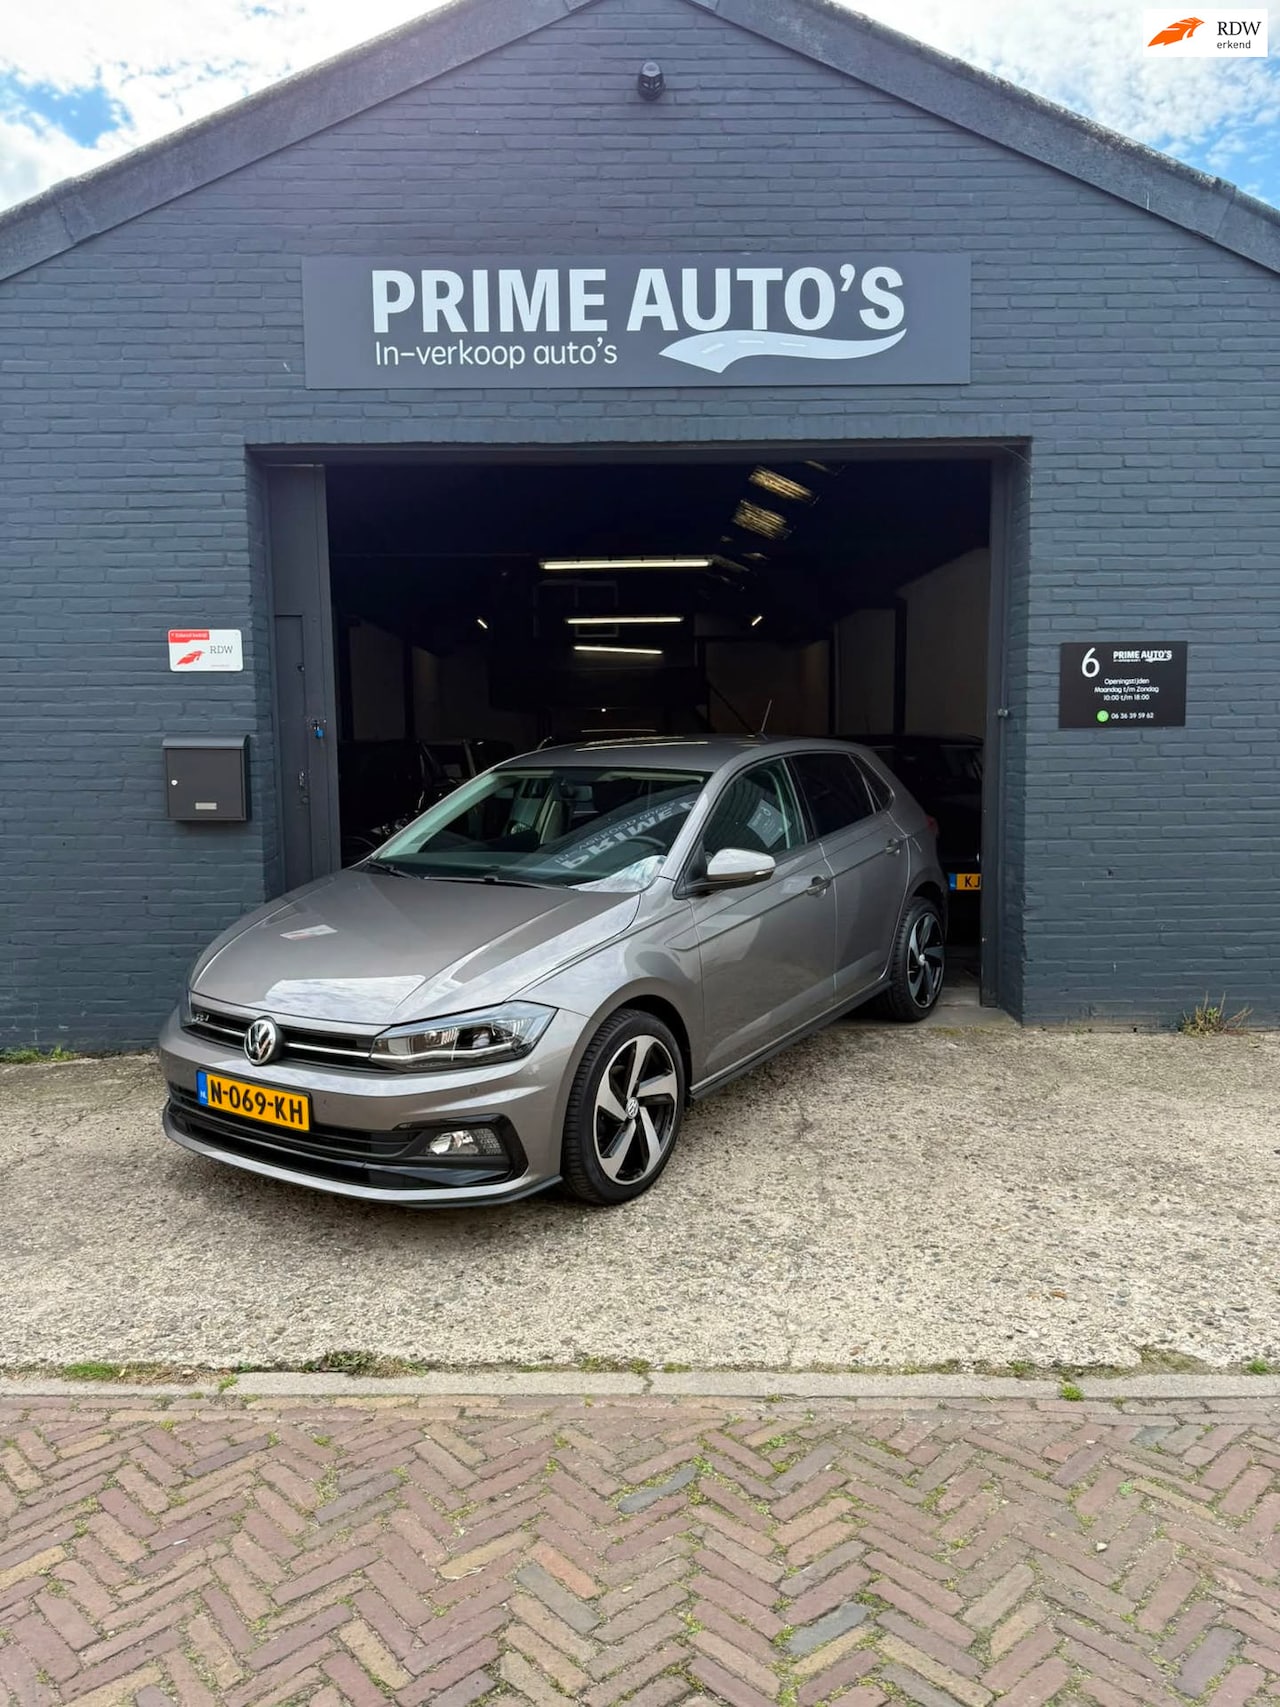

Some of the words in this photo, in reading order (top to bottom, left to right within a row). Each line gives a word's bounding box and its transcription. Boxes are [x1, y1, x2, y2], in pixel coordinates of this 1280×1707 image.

[372, 269, 608, 333] PRIME
[626, 264, 905, 332] AUTO'S
[375, 340, 526, 369] In-verkoop
[533, 337, 618, 365] auto's
[210, 645, 233, 654] RDW
[1081, 647, 1100, 678] 6
[1113, 650, 1140, 659] PRIME
[1141, 650, 1172, 660] AUTO'S
[210, 1079, 303, 1125] N-069-KH
